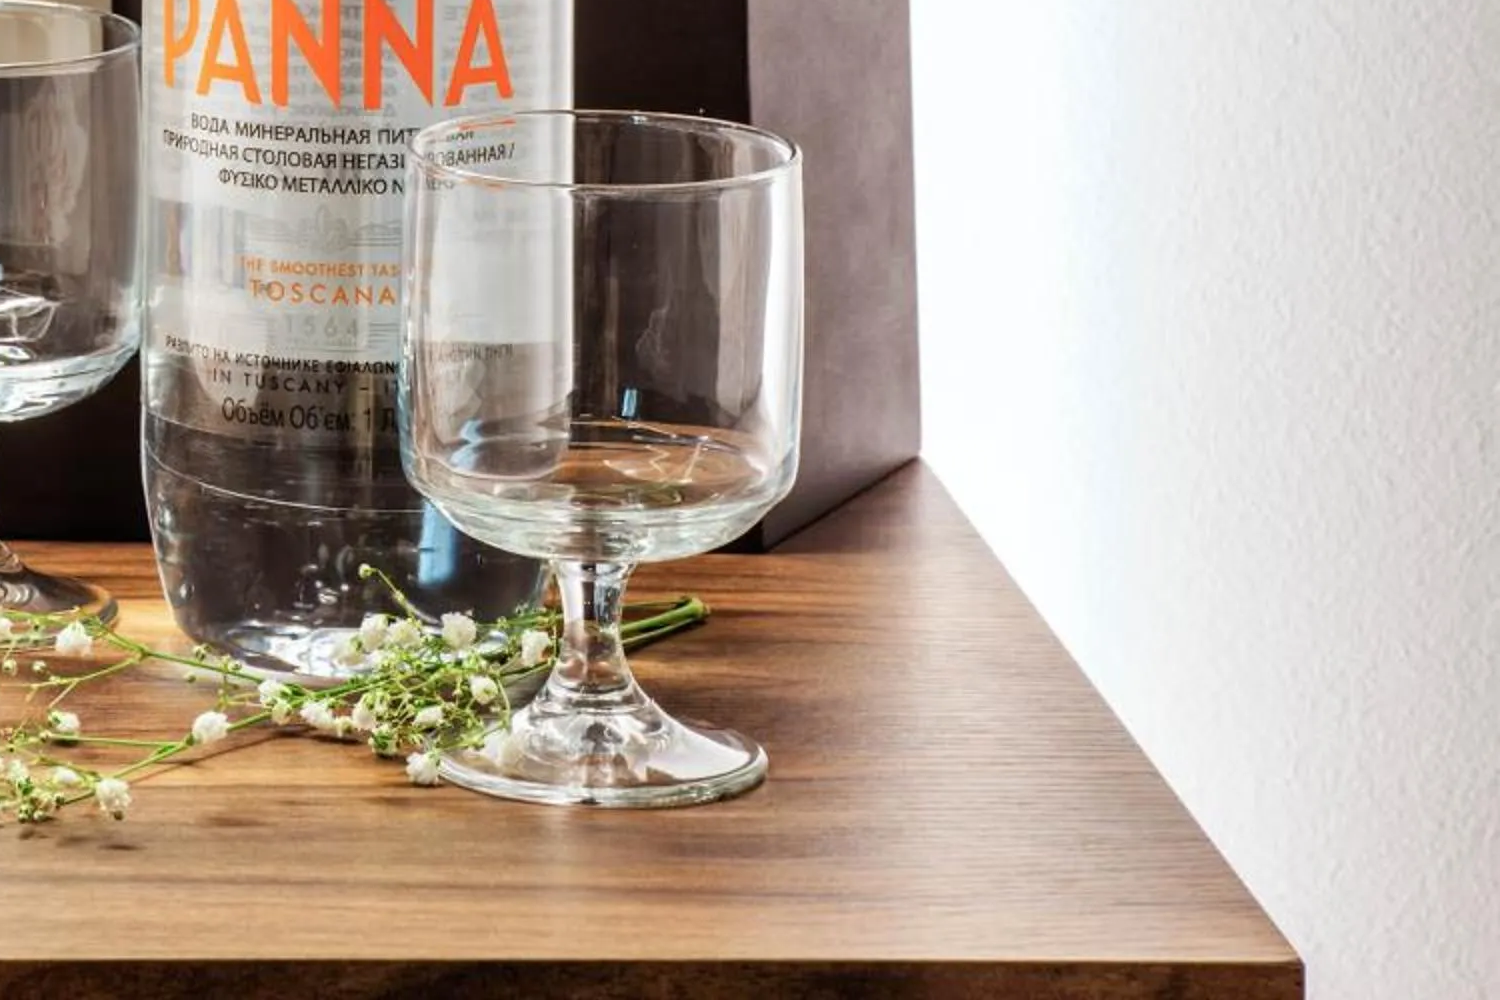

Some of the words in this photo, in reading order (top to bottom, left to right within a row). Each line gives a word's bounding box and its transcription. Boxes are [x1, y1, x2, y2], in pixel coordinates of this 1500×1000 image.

[191, 112, 230, 134] ВОДА
[236, 120, 371, 145] МИНЕРАЛЬНАЯ
[162, 129, 239, 160] ПРИРОДНАЯ
[243, 147, 337, 169] СТОЛОВАЯ
[271, 259, 364, 278] SMOOTHEST
[249, 279, 396, 305] TOSCANA
[286, 314, 359, 338] 1564
[213, 348, 231, 363] НА
[213, 368, 231, 384] IN
[244, 373, 345, 394] TUSCANY
[221, 396, 284, 428] Объём
